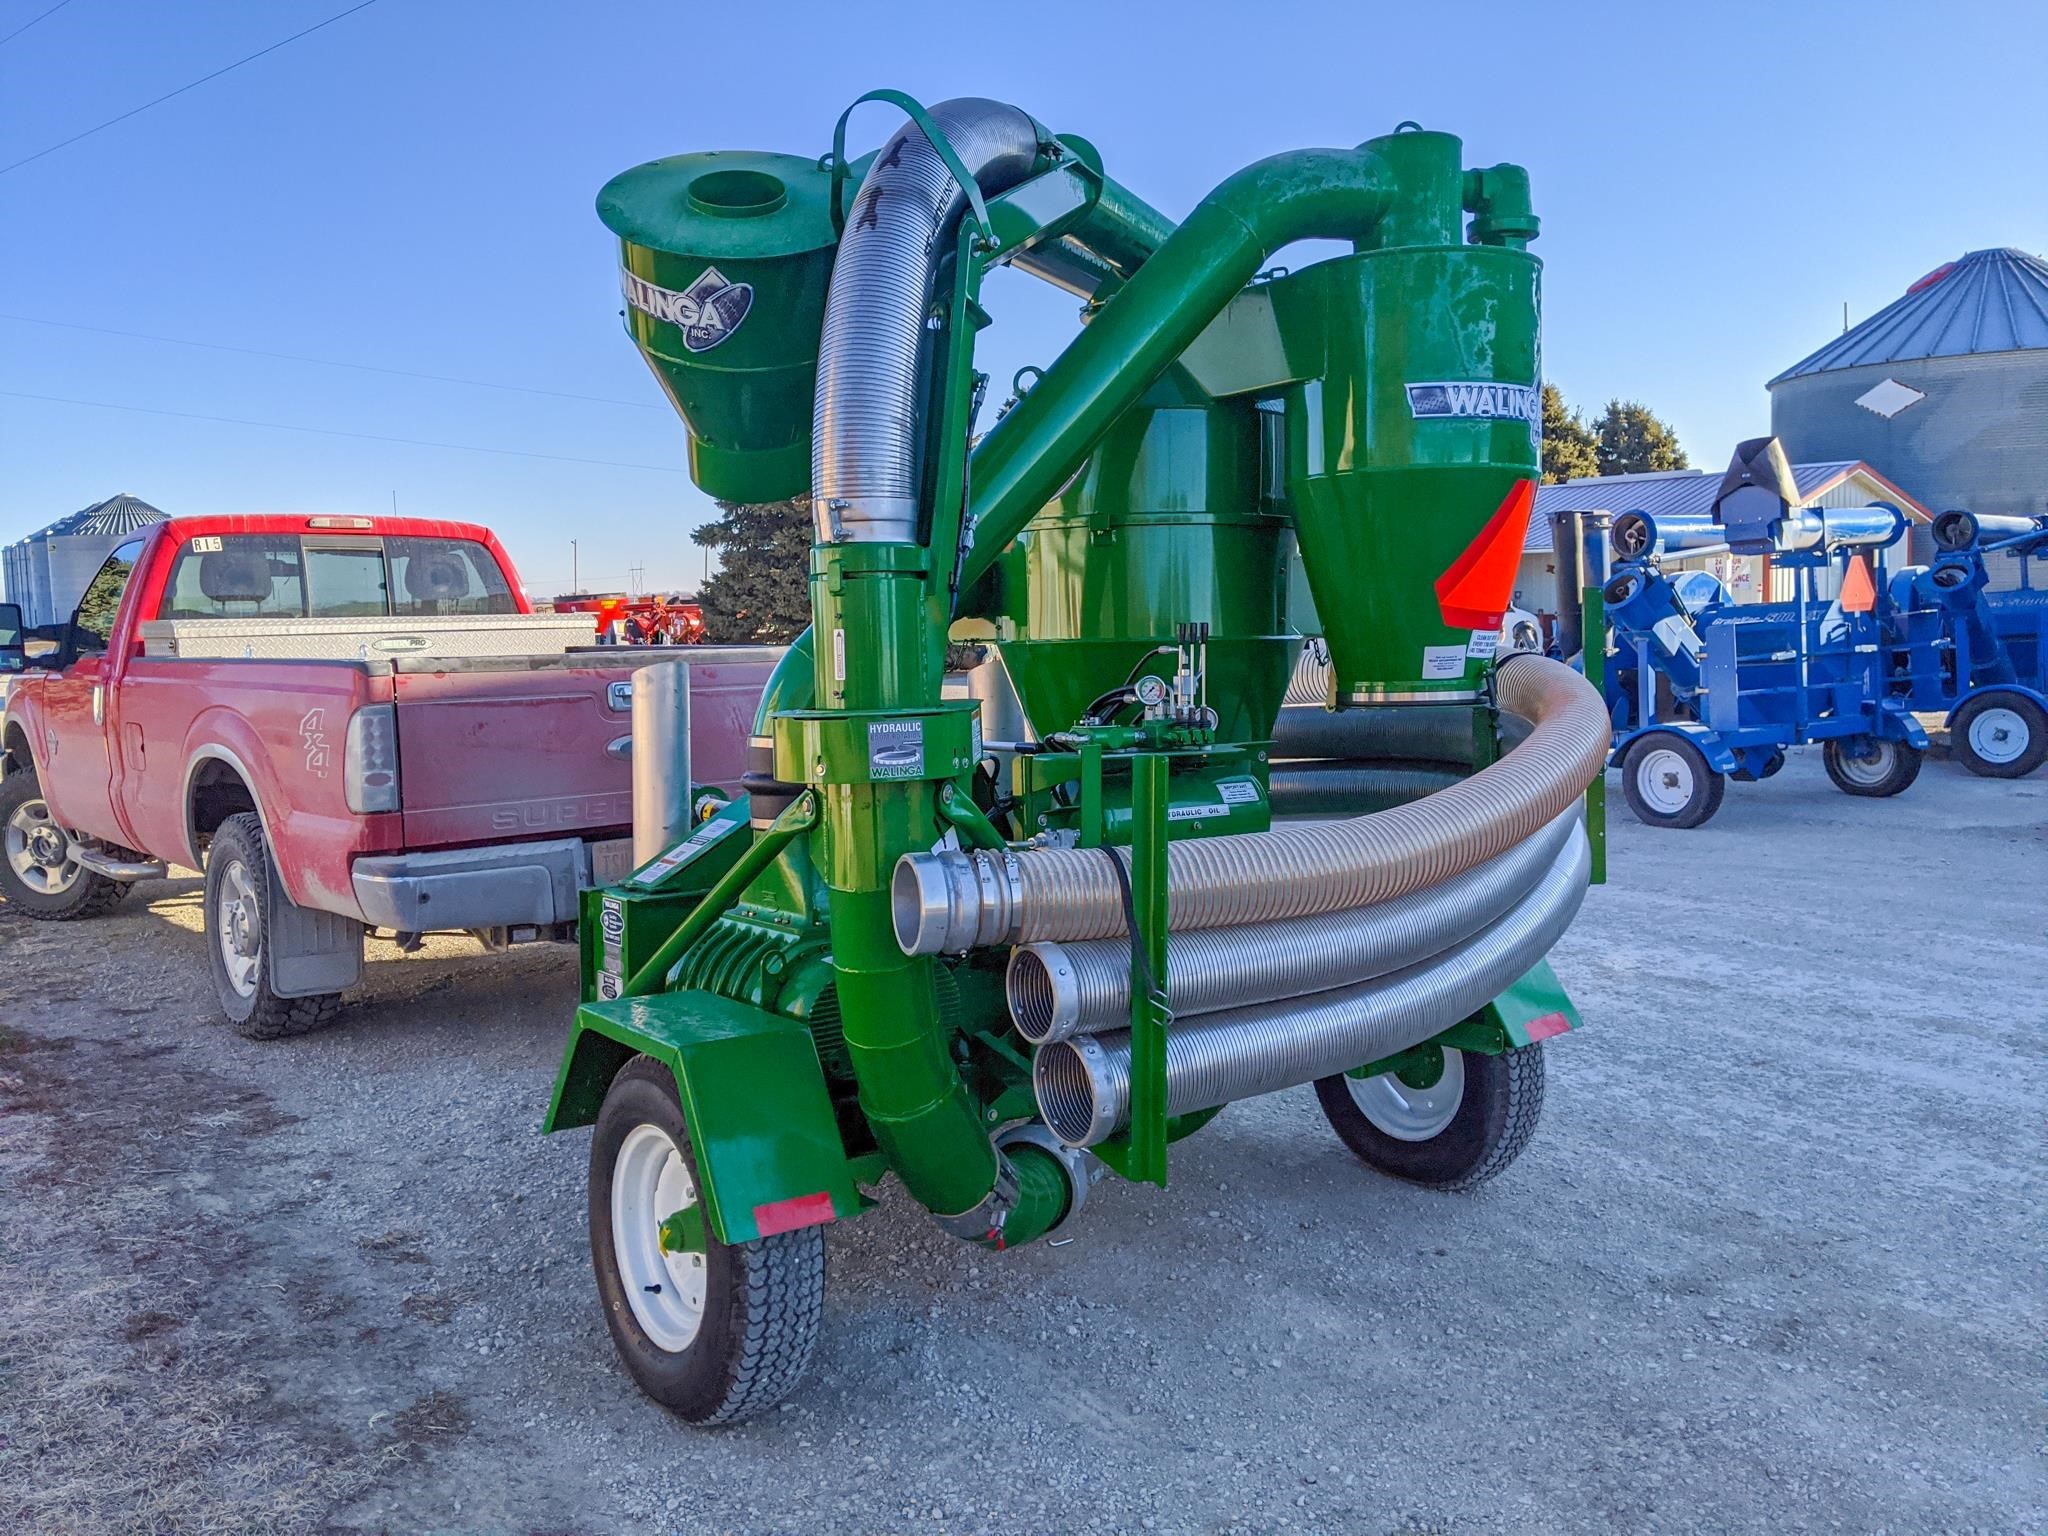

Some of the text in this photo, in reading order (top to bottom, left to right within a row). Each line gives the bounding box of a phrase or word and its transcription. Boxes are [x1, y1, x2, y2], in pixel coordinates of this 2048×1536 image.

[622, 271, 726, 331] ALINGA
[1446, 386, 1539, 420] WALING
[869, 722, 921, 734] HYDRAULIC
[871, 766, 923, 777] WALINGA
[1168, 809, 1202, 818] DRAULIC
